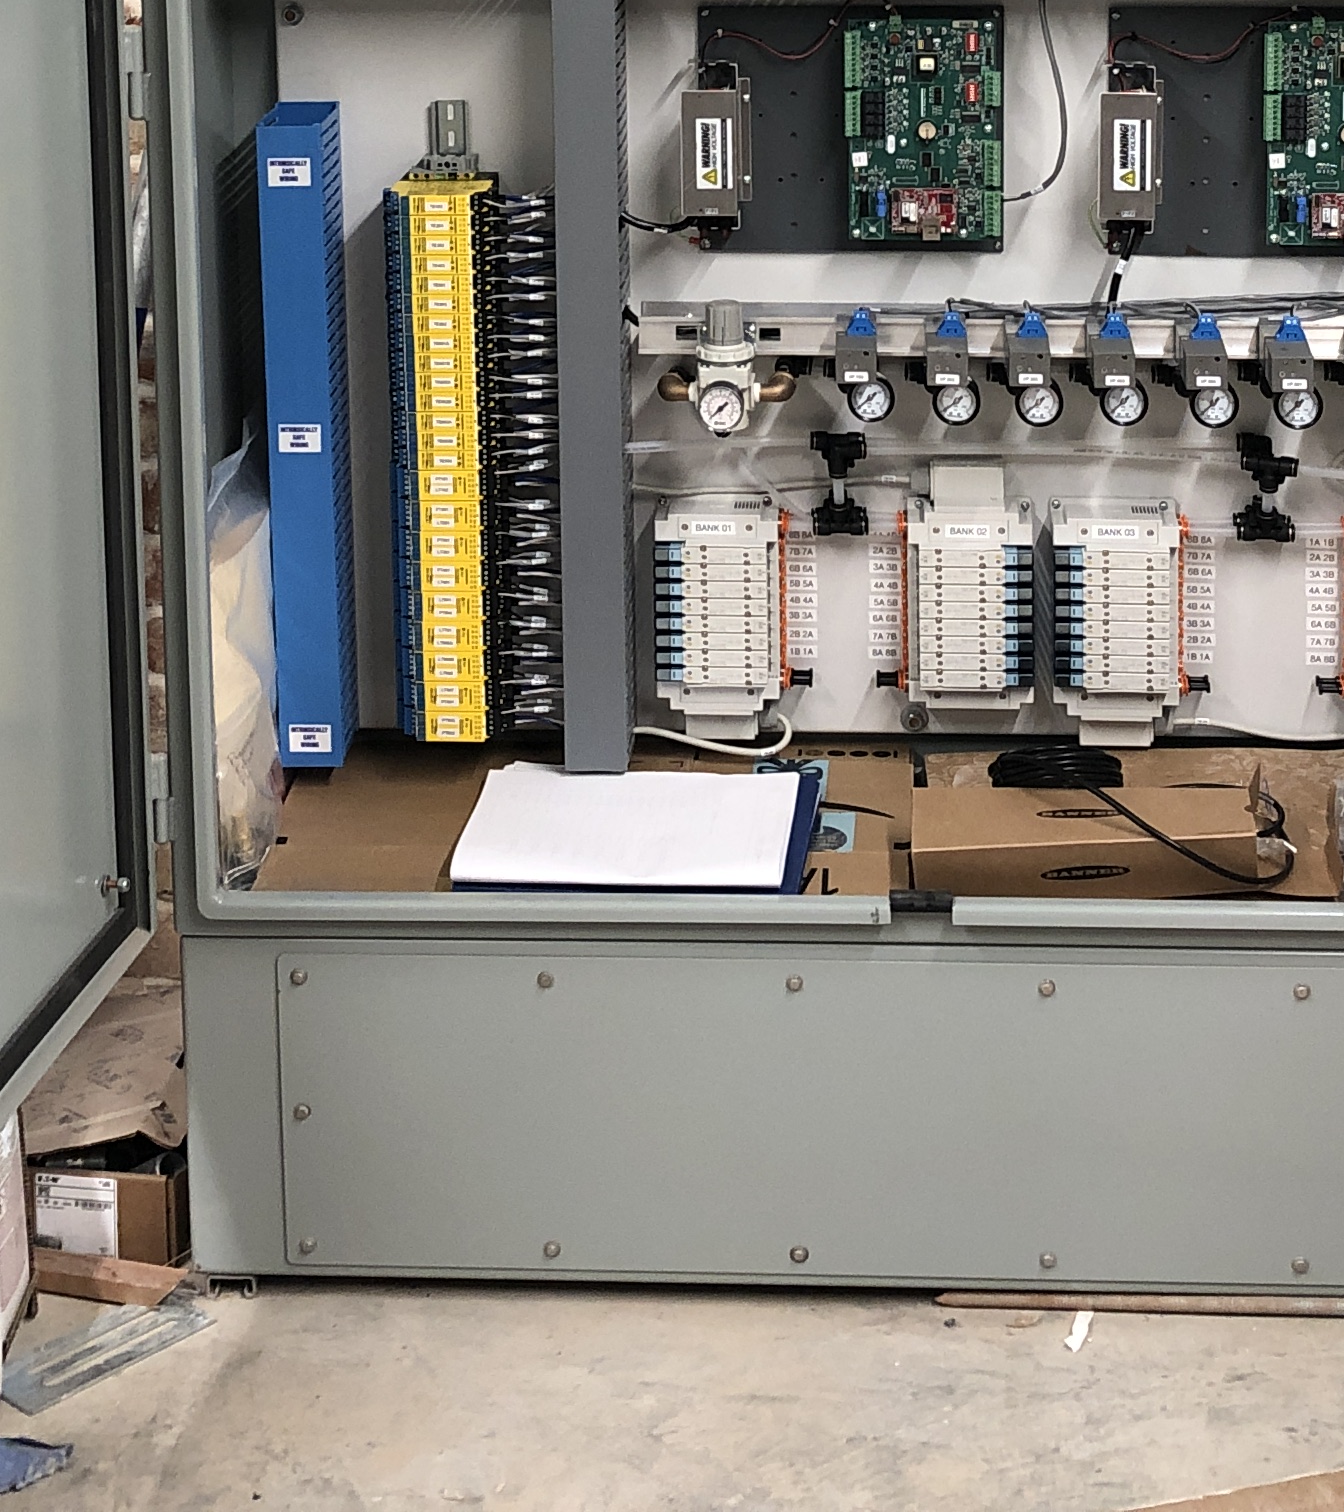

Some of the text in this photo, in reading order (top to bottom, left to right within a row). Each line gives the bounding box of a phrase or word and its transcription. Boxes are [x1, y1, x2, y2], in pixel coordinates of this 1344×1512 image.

[701, 123, 711, 168] WARNING!
[1118, 123, 1129, 169] WARNING!
[695, 523, 732, 533] BANK 01
[1310, 538, 1334, 546] 1A 1B
[789, 547, 813, 555] 7B 7A
[1309, 554, 1334, 562] 2A 2B
[873, 563, 897, 571] 3A 3B
[1309, 586, 1334, 594] 4A 4B
[1311, 603, 1336, 611] 5A 5B
[1186, 620, 1211, 628] 3B 3A
[1311, 620, 1336, 628] 6A 6B
[1310, 638, 1335, 646] 7A 7B
[1046, 868, 1124, 878] BANNER
